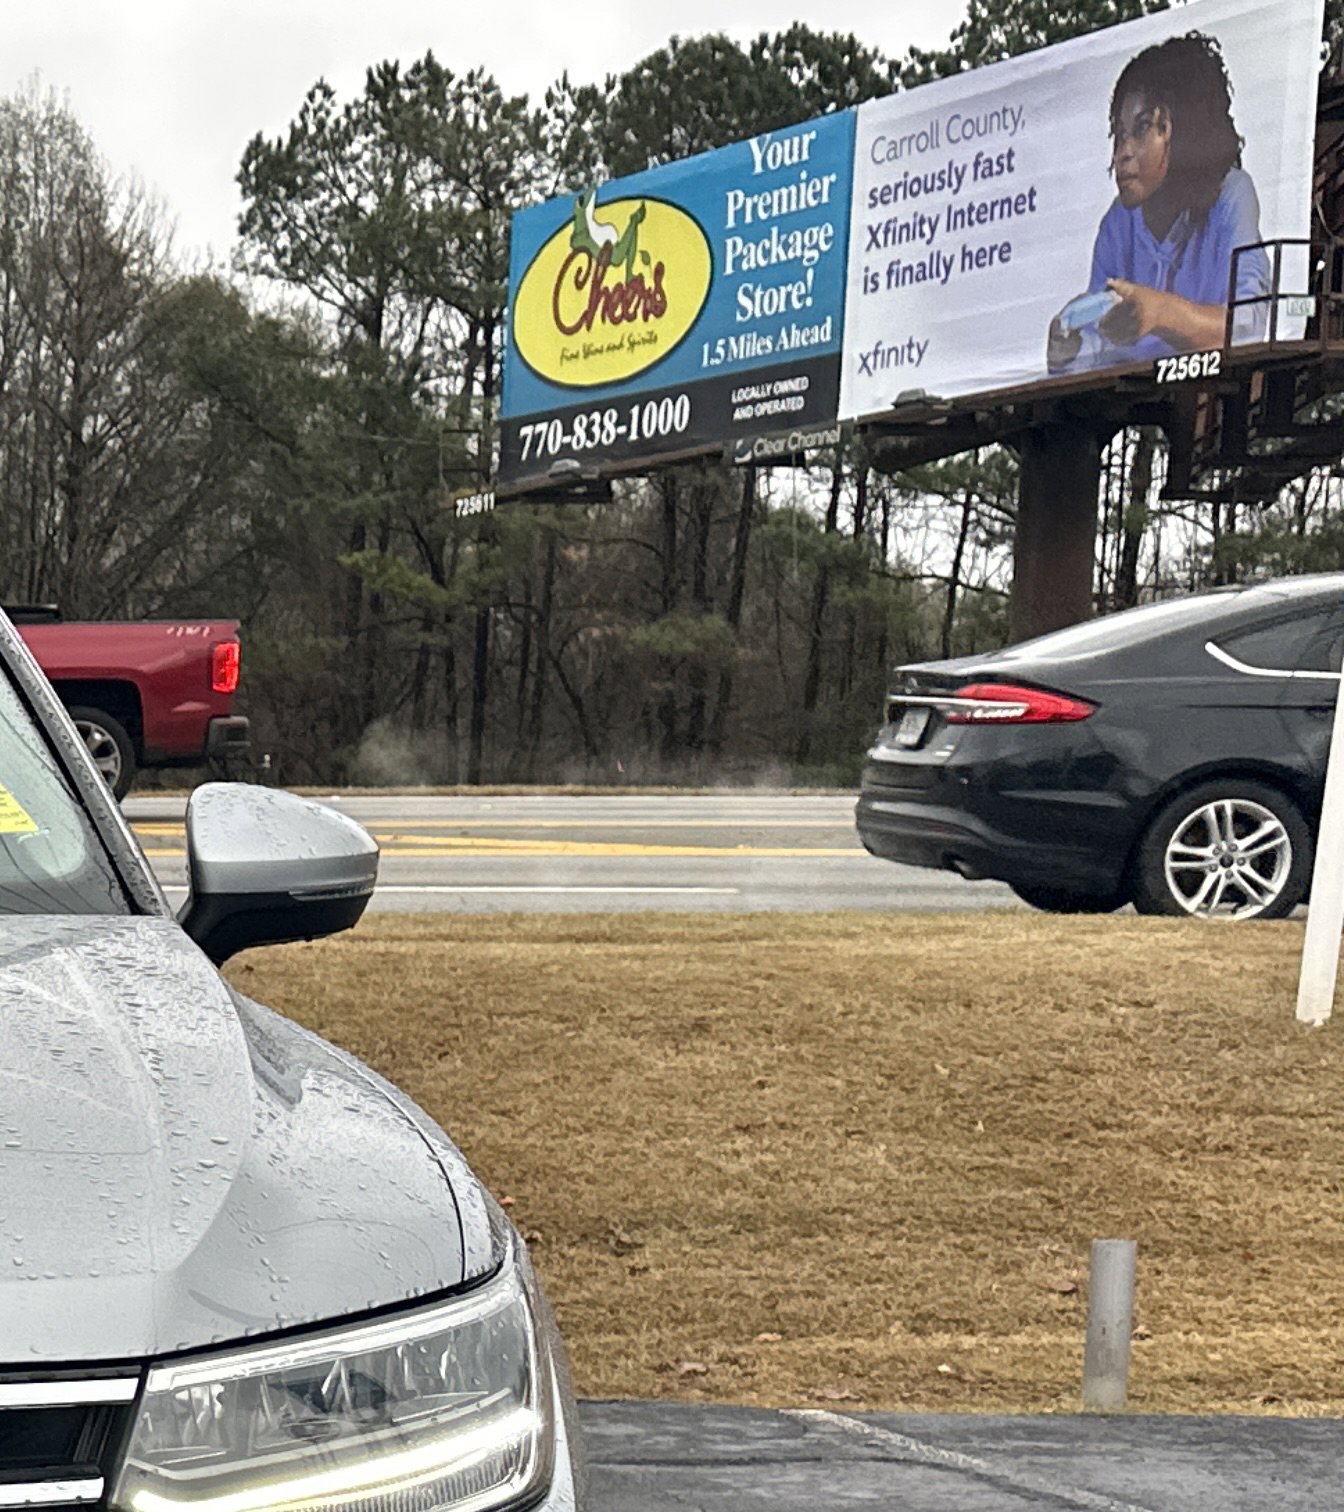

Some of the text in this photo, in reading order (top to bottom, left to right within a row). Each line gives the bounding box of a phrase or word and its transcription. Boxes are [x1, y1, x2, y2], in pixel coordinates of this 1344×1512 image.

[748, 130, 817, 175] Your
[870, 104, 1026, 165] Carroll County,
[724, 170, 836, 229] Premier
[868, 146, 1015, 209] seriously fast
[865, 186, 1037, 252] Xfinity Internet
[723, 222, 834, 276] Package
[863, 240, 1012, 295] is finally here
[552, 244, 667, 335] Cheers
[735, 267, 814, 322] Store!
[606, 333, 624, 352] and
[701, 315, 832, 368] 1.5 Miles Ahead
[857, 337, 929, 377] xfinity
[1155, 350, 1222, 383] 725612
[731, 376, 810, 403] LOCALLY OWNED
[732, 396, 805, 420] AND OPERATED
[518, 394, 690, 461] 770-838-1000
[753, 424, 842, 457] Clear Channel
